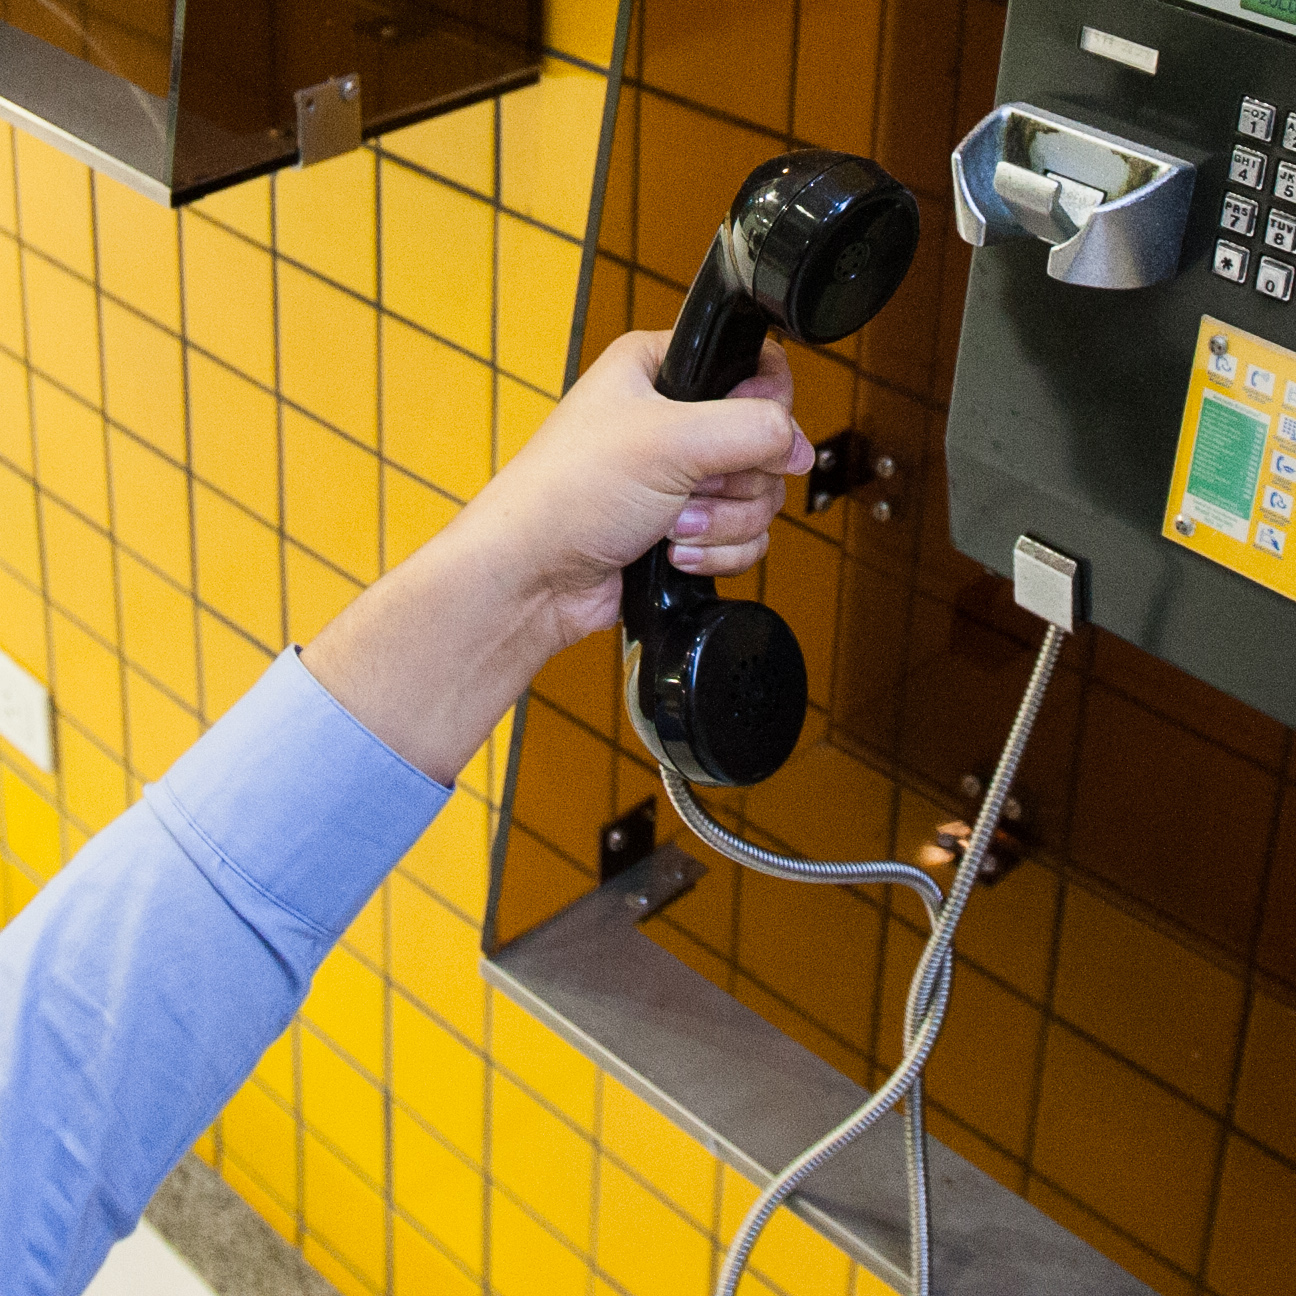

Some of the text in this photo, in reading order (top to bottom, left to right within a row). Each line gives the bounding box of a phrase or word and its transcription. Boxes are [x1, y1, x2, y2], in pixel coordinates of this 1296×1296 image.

[1250, 121, 1257, 134] 1
[1234, 154, 1256, 169] GHI
[1238, 168, 1248, 181] 4
[1283, 185, 1294, 197] 5
[1224, 201, 1248, 216] PRS
[1229, 214, 1240, 228] 7
[1270, 218, 1293, 234] TUV
[1273, 232, 1284, 245] 8
[1265, 280, 1276, 293] 0
